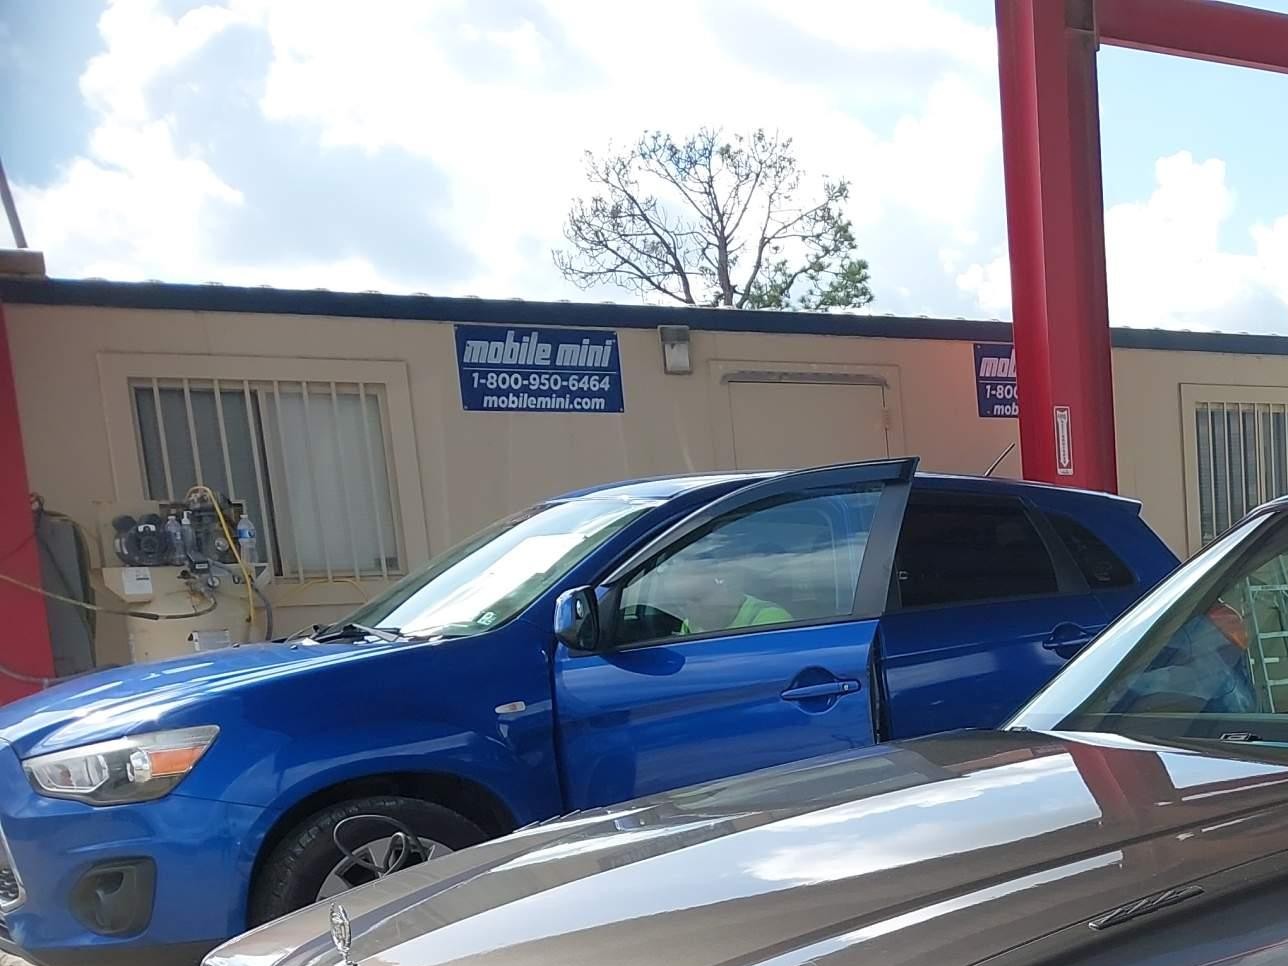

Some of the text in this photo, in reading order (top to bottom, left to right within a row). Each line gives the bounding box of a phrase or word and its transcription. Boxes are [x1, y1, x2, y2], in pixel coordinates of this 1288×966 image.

[463, 330, 614, 367] mobile mini
[472, 372, 611, 391] 1-800-950-6464
[483, 393, 606, 410] mobilemini.com
